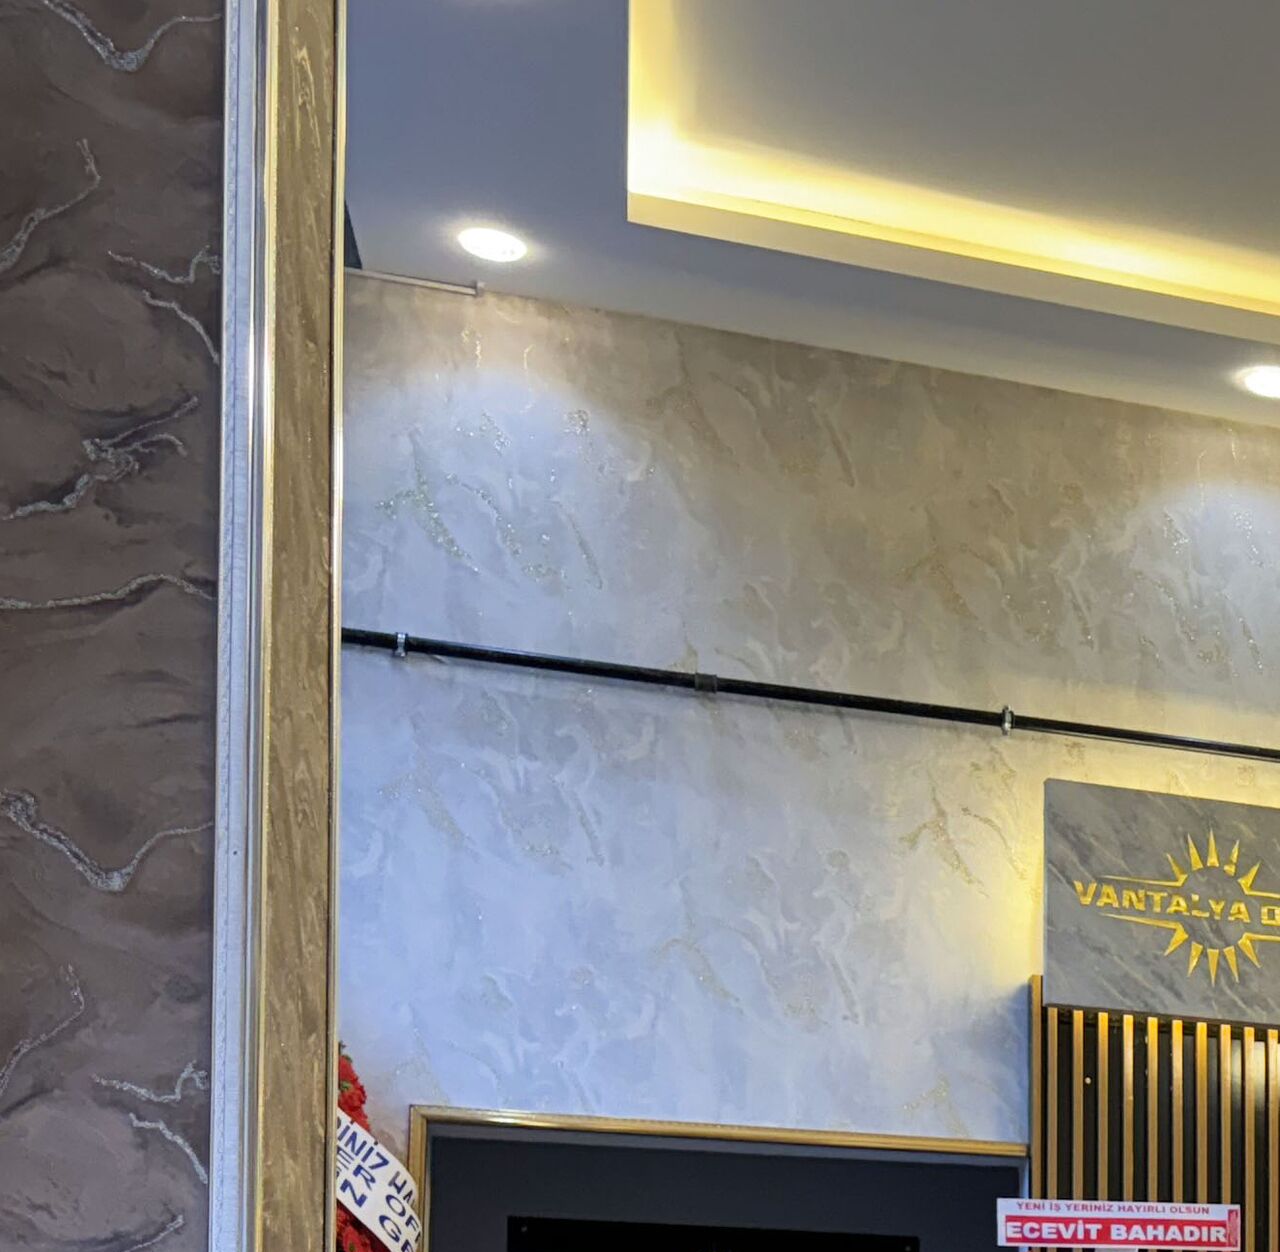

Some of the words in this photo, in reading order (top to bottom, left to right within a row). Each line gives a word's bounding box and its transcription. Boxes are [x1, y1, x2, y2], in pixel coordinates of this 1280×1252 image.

[1074, 880, 1250, 922] VANTALYA
[1016, 1201, 1045, 1211] YENİ
[1049, 1201, 1061, 1212] İŞ
[1065, 1202, 1113, 1213] YERİNİZ
[1118, 1204, 1166, 1214] HAYIRLI
[1169, 1206, 1210, 1215] OLSUN
[1006, 1219, 1102, 1240] ECEVİT
[1111, 1224, 1227, 1243] BAHADIR
